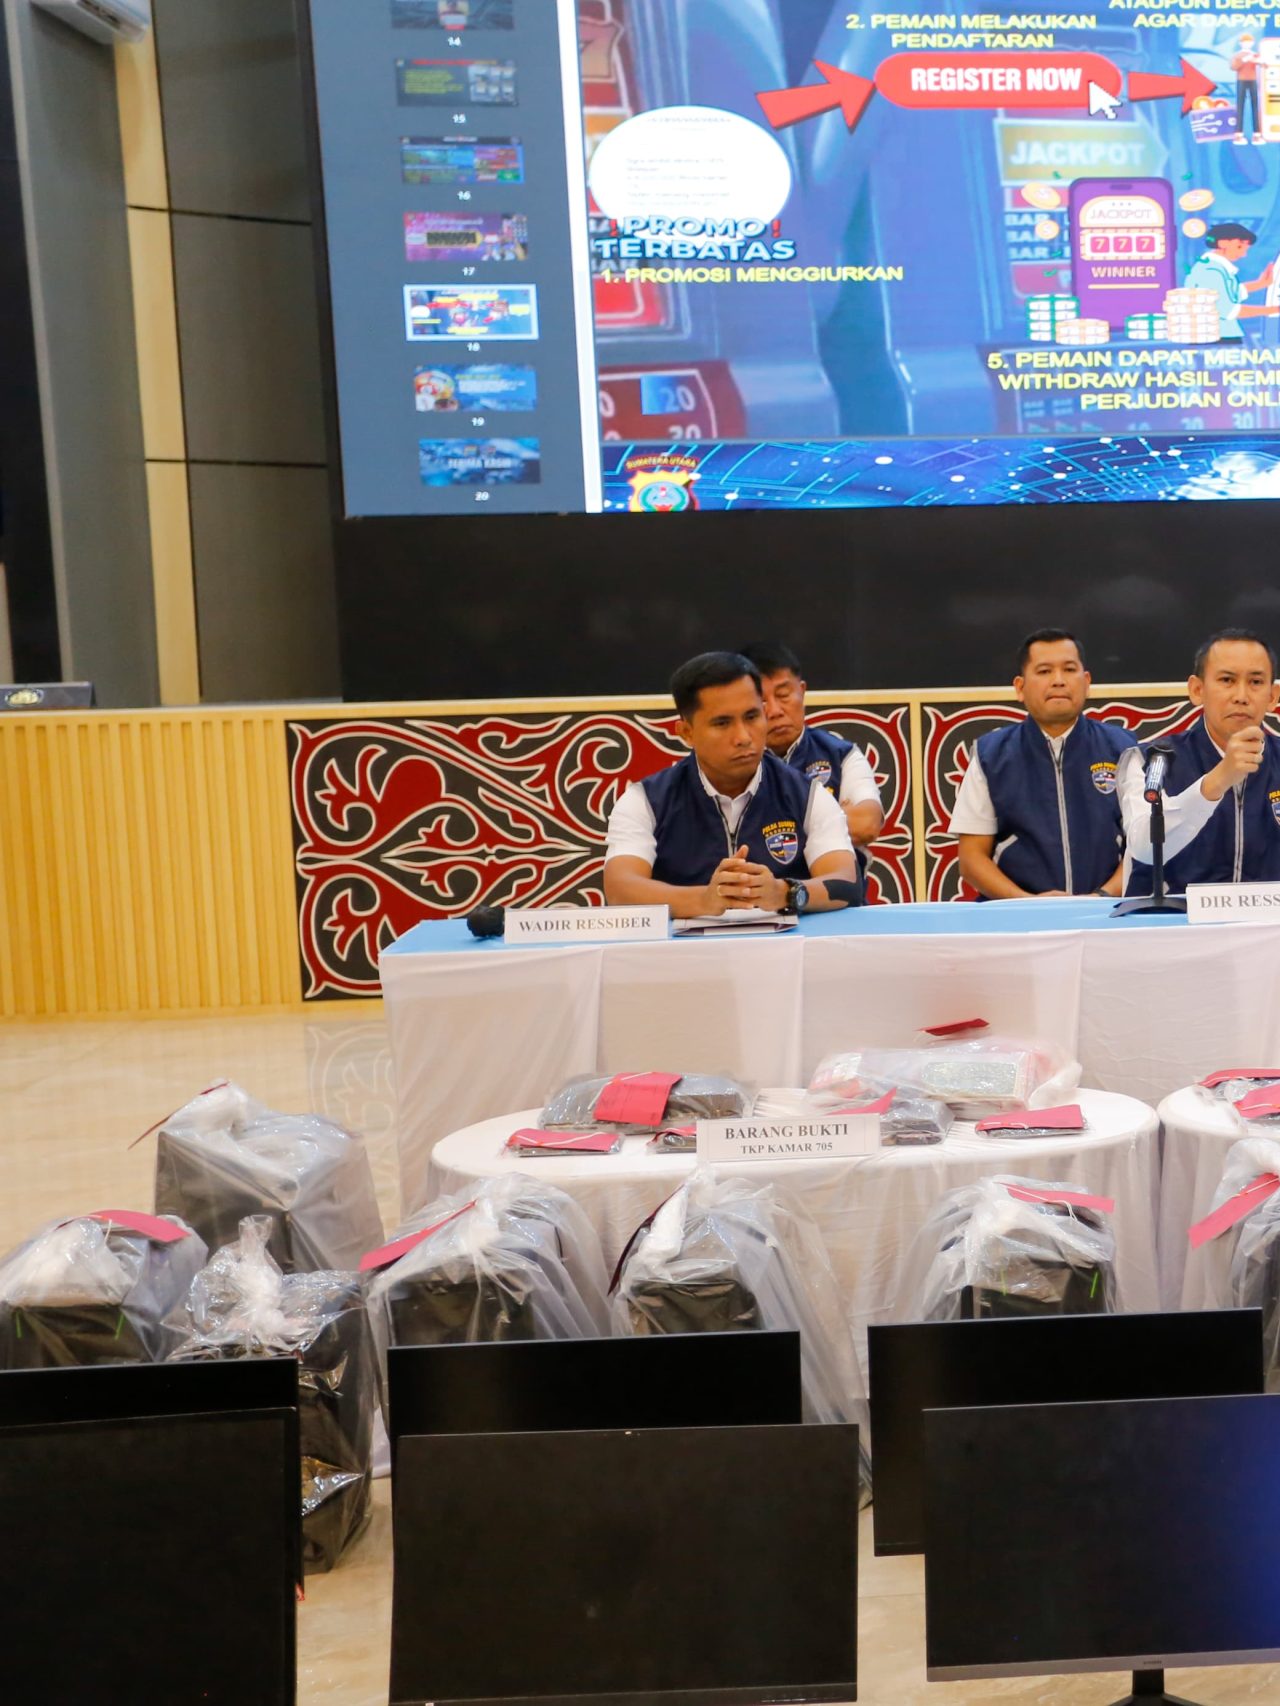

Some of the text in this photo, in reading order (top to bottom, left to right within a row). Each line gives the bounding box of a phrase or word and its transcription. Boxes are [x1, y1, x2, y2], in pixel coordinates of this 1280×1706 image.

[846, 14, 1096, 29] 2. PEMAIN MELAKUKAN
[1133, 13, 1197, 28] AGAR
[1200, 13, 1270, 28] DAPAT
[891, 33, 1054, 48] PENDAFTARAN
[911, 68, 1082, 91] REGISTER NOW
[1010, 141, 1145, 165] JACKPOT
[1090, 209, 1151, 219] JACKPOT
[623, 215, 766, 238] PROMO
[594, 237, 796, 261] TERBATAS
[1095, 238, 1150, 249] 7 7 7
[601, 266, 904, 284] 1. PROMOSI MENGGIURKAN
[1091, 267, 1156, 278] WINNER
[988, 353, 1009, 369] 5.
[1016, 351, 1112, 368] PEMAIN
[1118, 350, 1198, 367] DAPAT
[998, 372, 1140, 390] WITHDRAW
[1145, 371, 1218, 387] HASIL
[1080, 392, 1222, 410] PERJUDIAN
[1199, 895, 1233, 909] DIR
[519, 916, 652, 932] WADIR RESSIBER
[725, 1123, 849, 1140] BARANG BUKTI
[740, 1141, 833, 1154] TKP KAMAR 705
